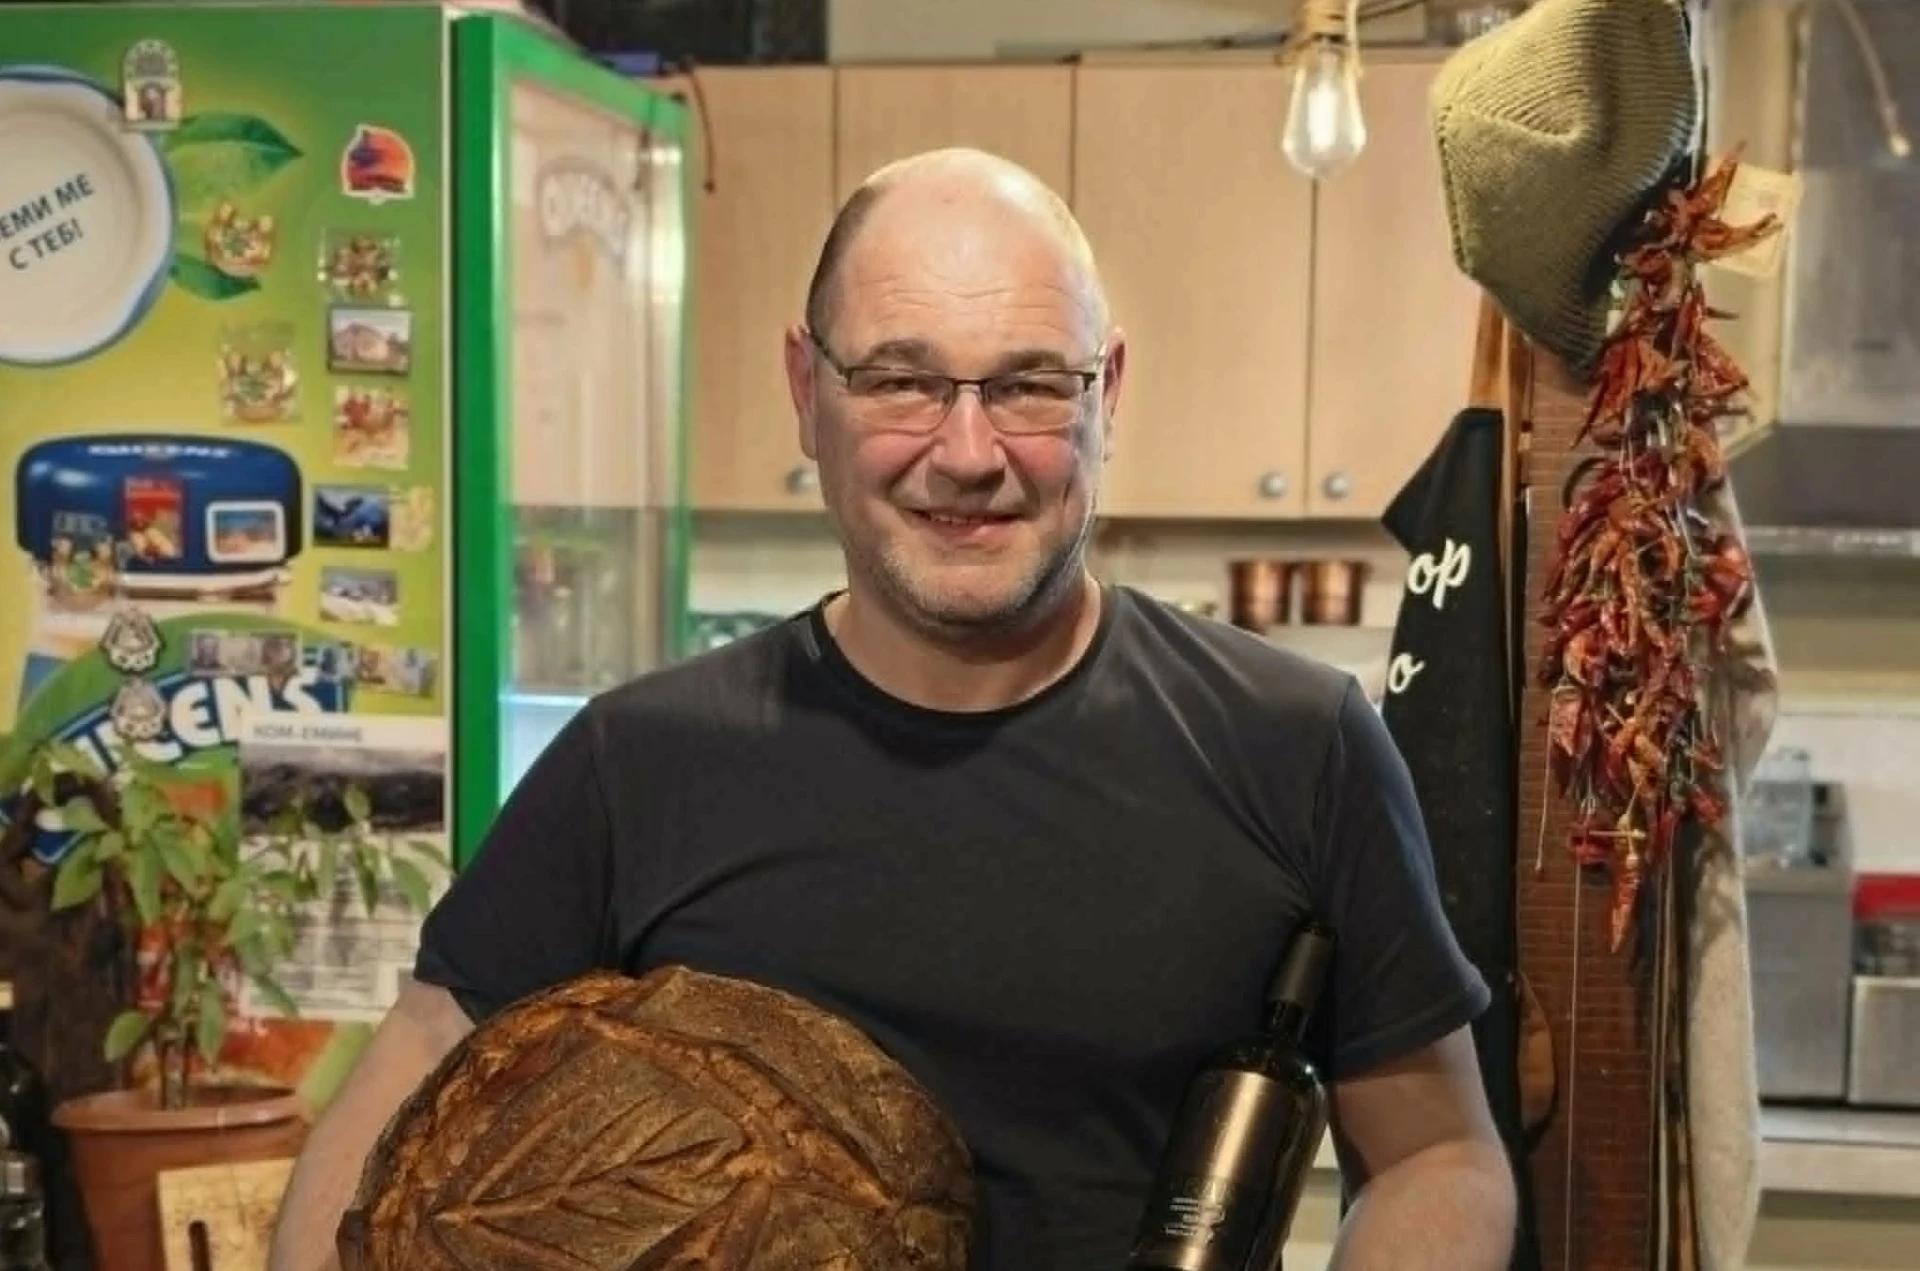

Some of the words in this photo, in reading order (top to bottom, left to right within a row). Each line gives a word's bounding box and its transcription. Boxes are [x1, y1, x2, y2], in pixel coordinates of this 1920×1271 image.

[55, 173, 95, 209] МЕ
[8, 245, 29, 271] С
[26, 217, 85, 259] ТЕБ!
